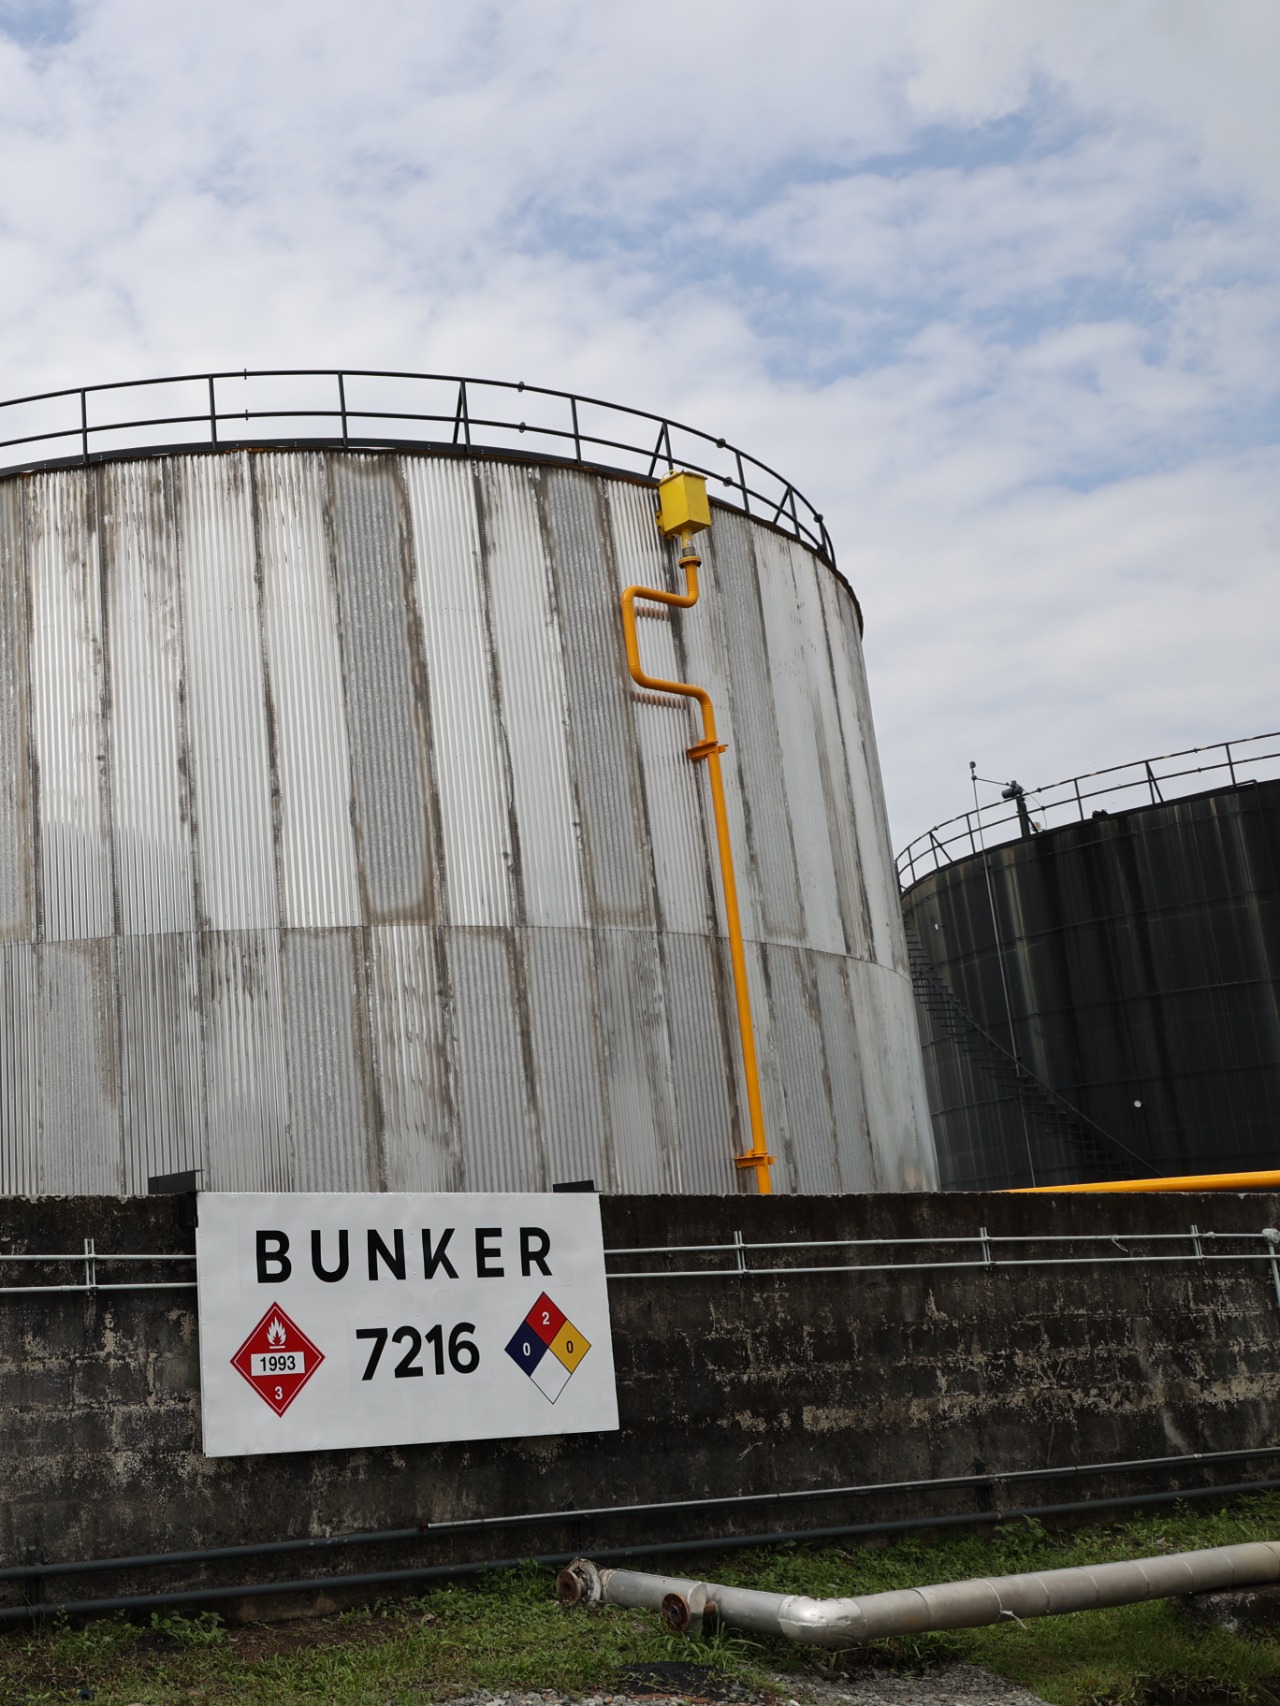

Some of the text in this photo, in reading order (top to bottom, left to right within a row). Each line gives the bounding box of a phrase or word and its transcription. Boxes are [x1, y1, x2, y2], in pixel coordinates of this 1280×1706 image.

[255, 1227, 552, 1284] BUNKER
[542, 1311, 550, 1325] 2
[356, 1322, 480, 1380] 7216
[522, 1342, 531, 1356] 0
[566, 1340, 574, 1354] 0
[260, 1355, 296, 1372] 1993
[274, 1386, 283, 1400] 3
